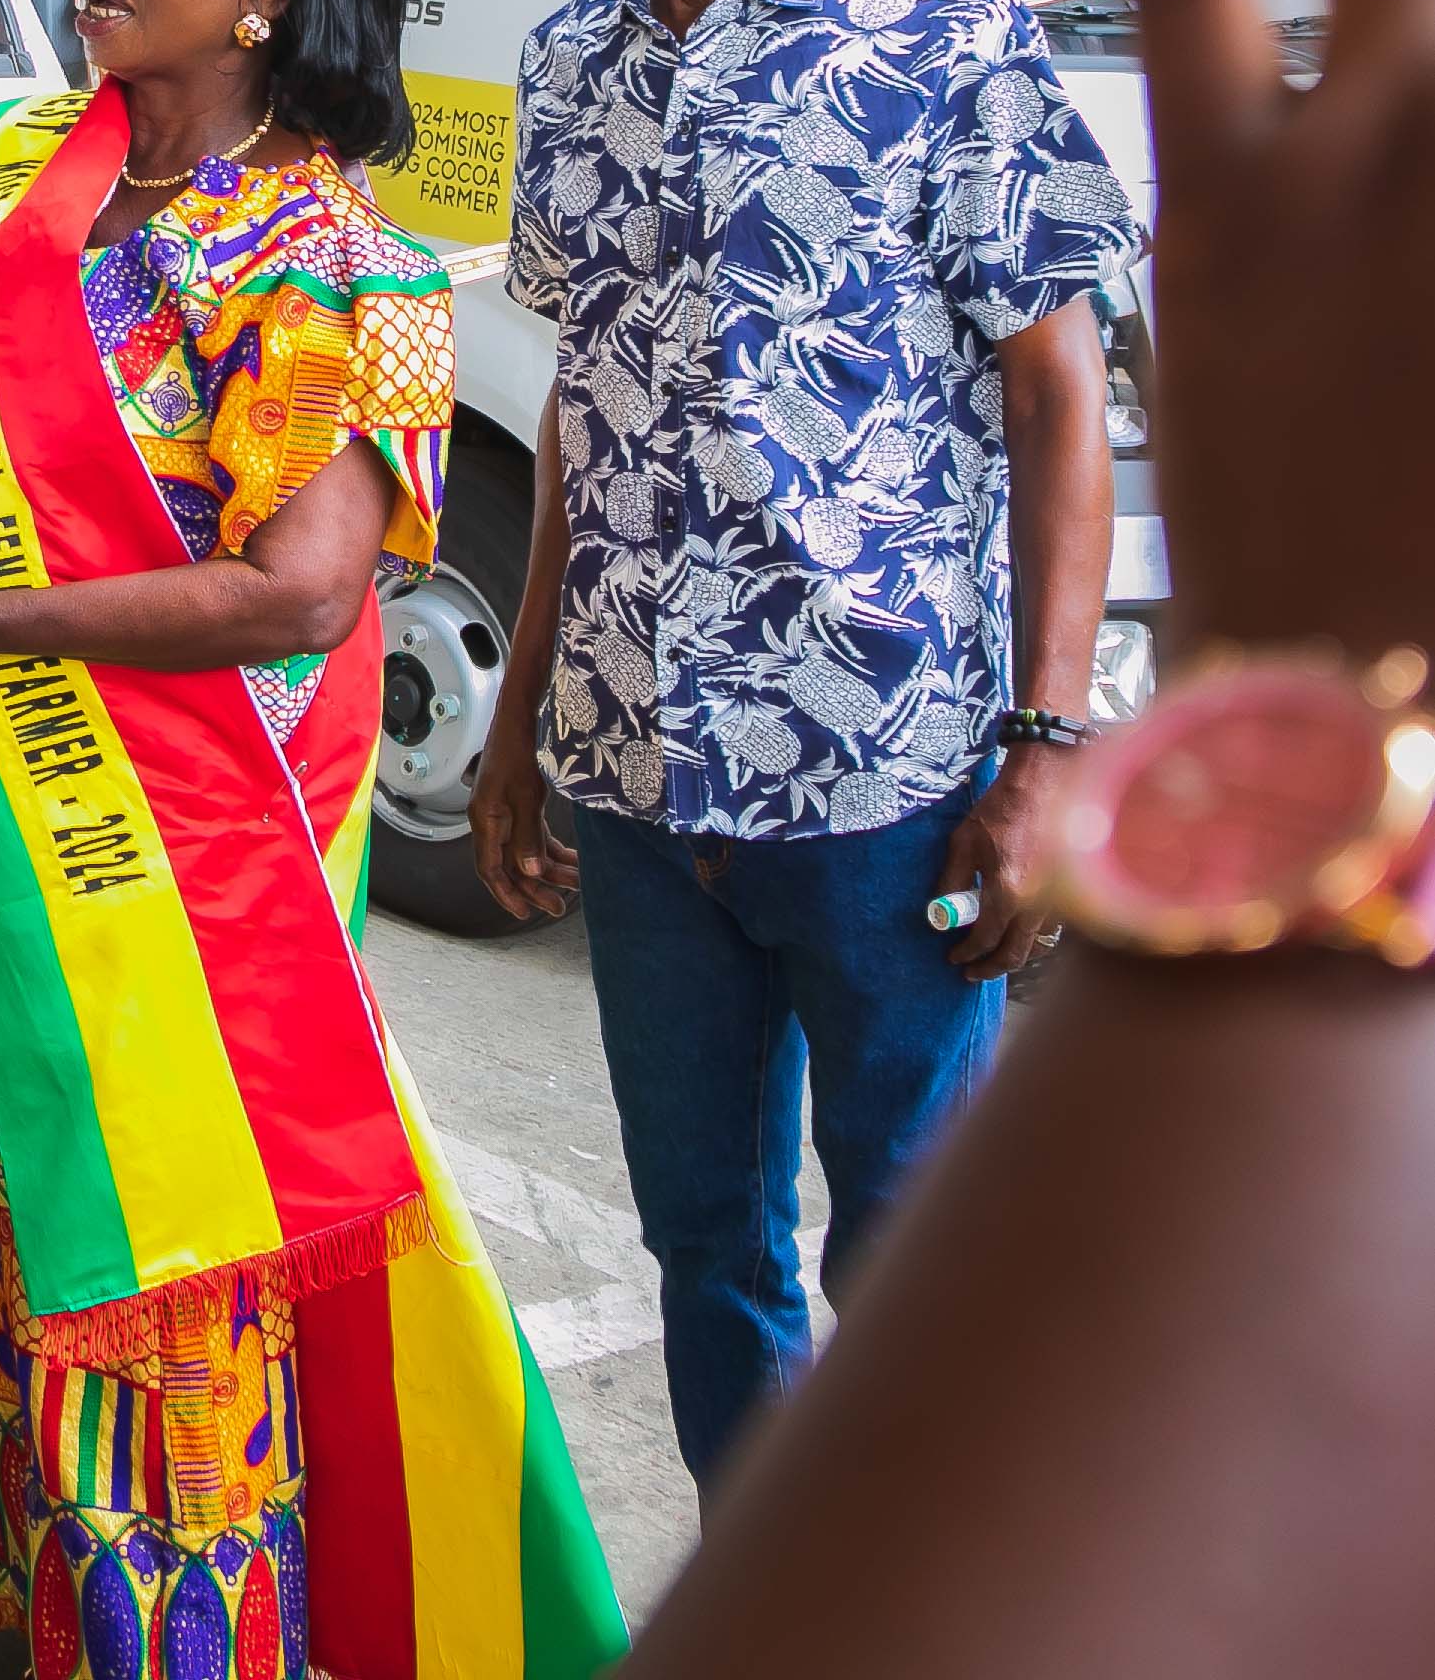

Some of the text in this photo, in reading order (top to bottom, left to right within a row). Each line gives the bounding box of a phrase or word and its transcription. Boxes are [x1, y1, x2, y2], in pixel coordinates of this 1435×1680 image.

[410, 102, 510, 138] 024-MOST
[418, 129, 505, 162] OMISING
[427, 156, 501, 189] COCOA
[420, 180, 499, 216] FARMER
[51, 813, 148, 896] 2024
